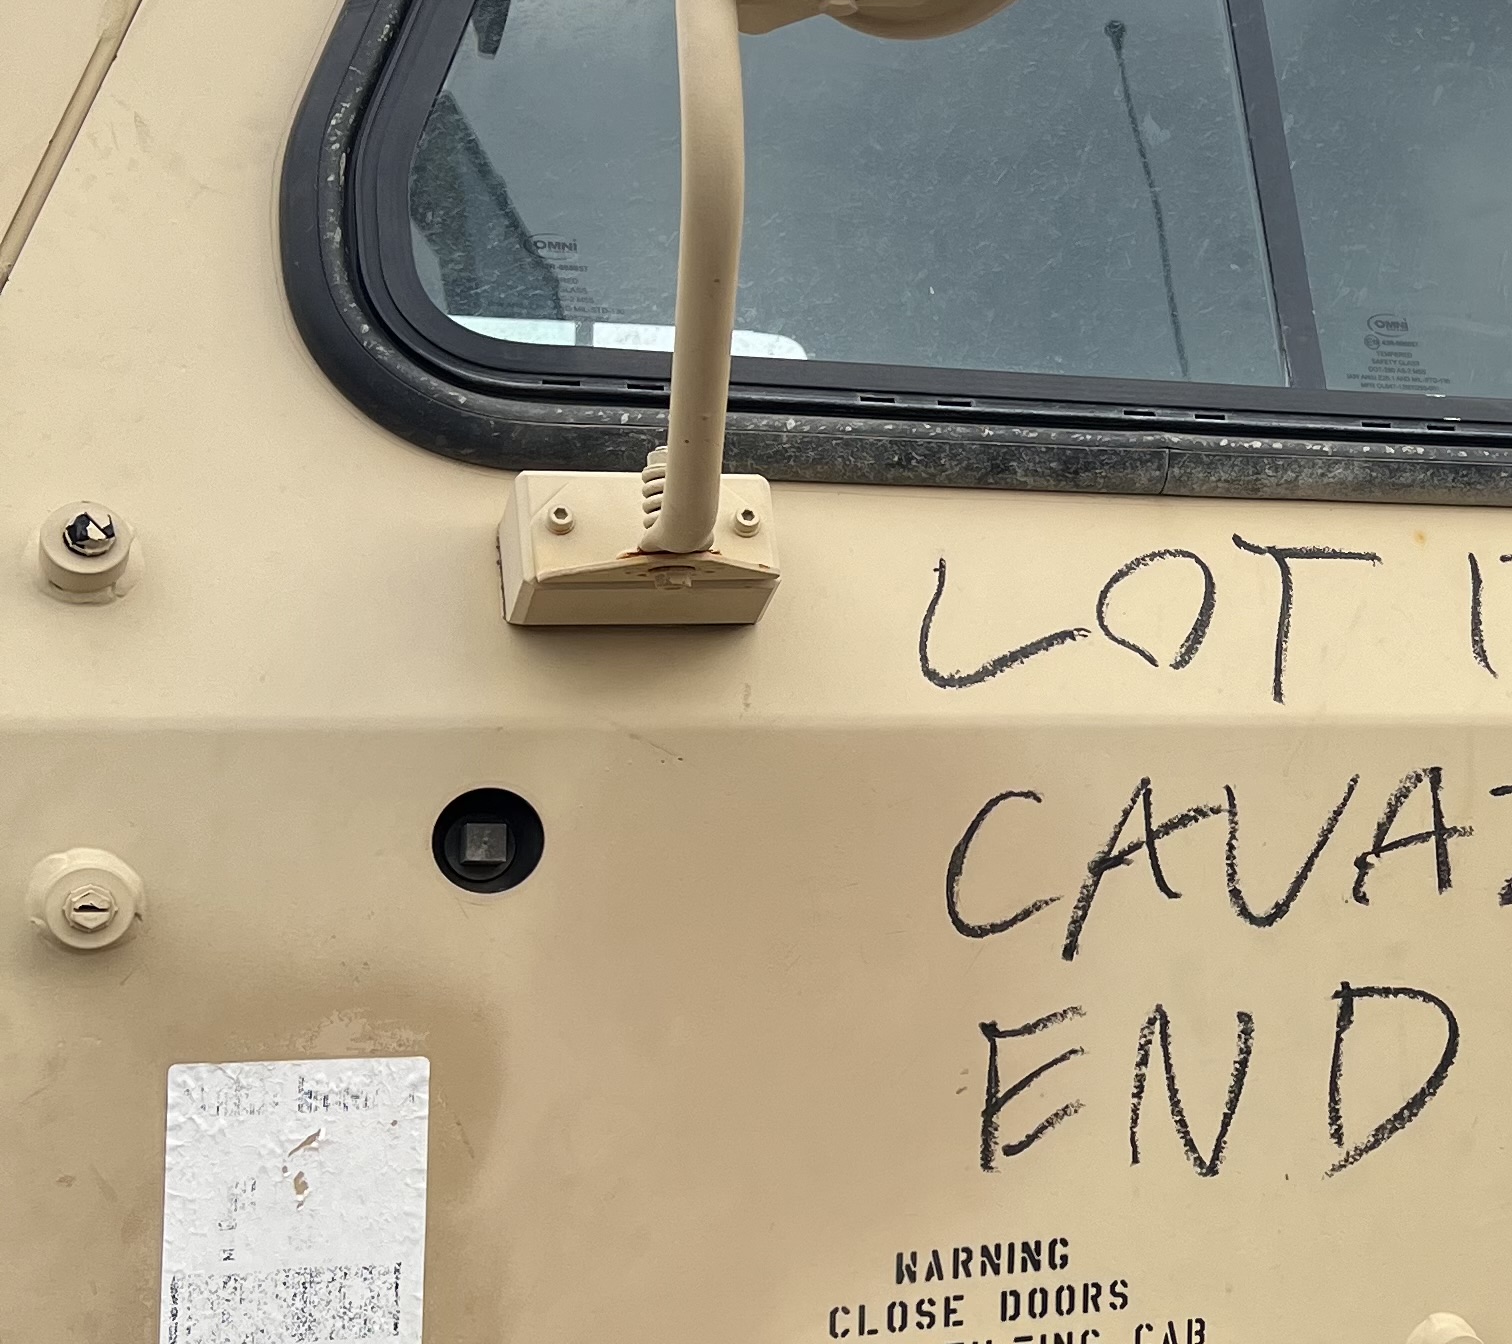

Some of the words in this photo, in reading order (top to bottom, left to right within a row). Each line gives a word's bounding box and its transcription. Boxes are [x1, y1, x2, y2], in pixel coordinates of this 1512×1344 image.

[919, 534, 1382, 703] LOT
[977, 981, 1460, 1178] END
[829, 1294, 965, 1339] CLOSE
[1000, 1279, 1129, 1323] DOORS
[895, 1237, 1070, 1285] WARNING
